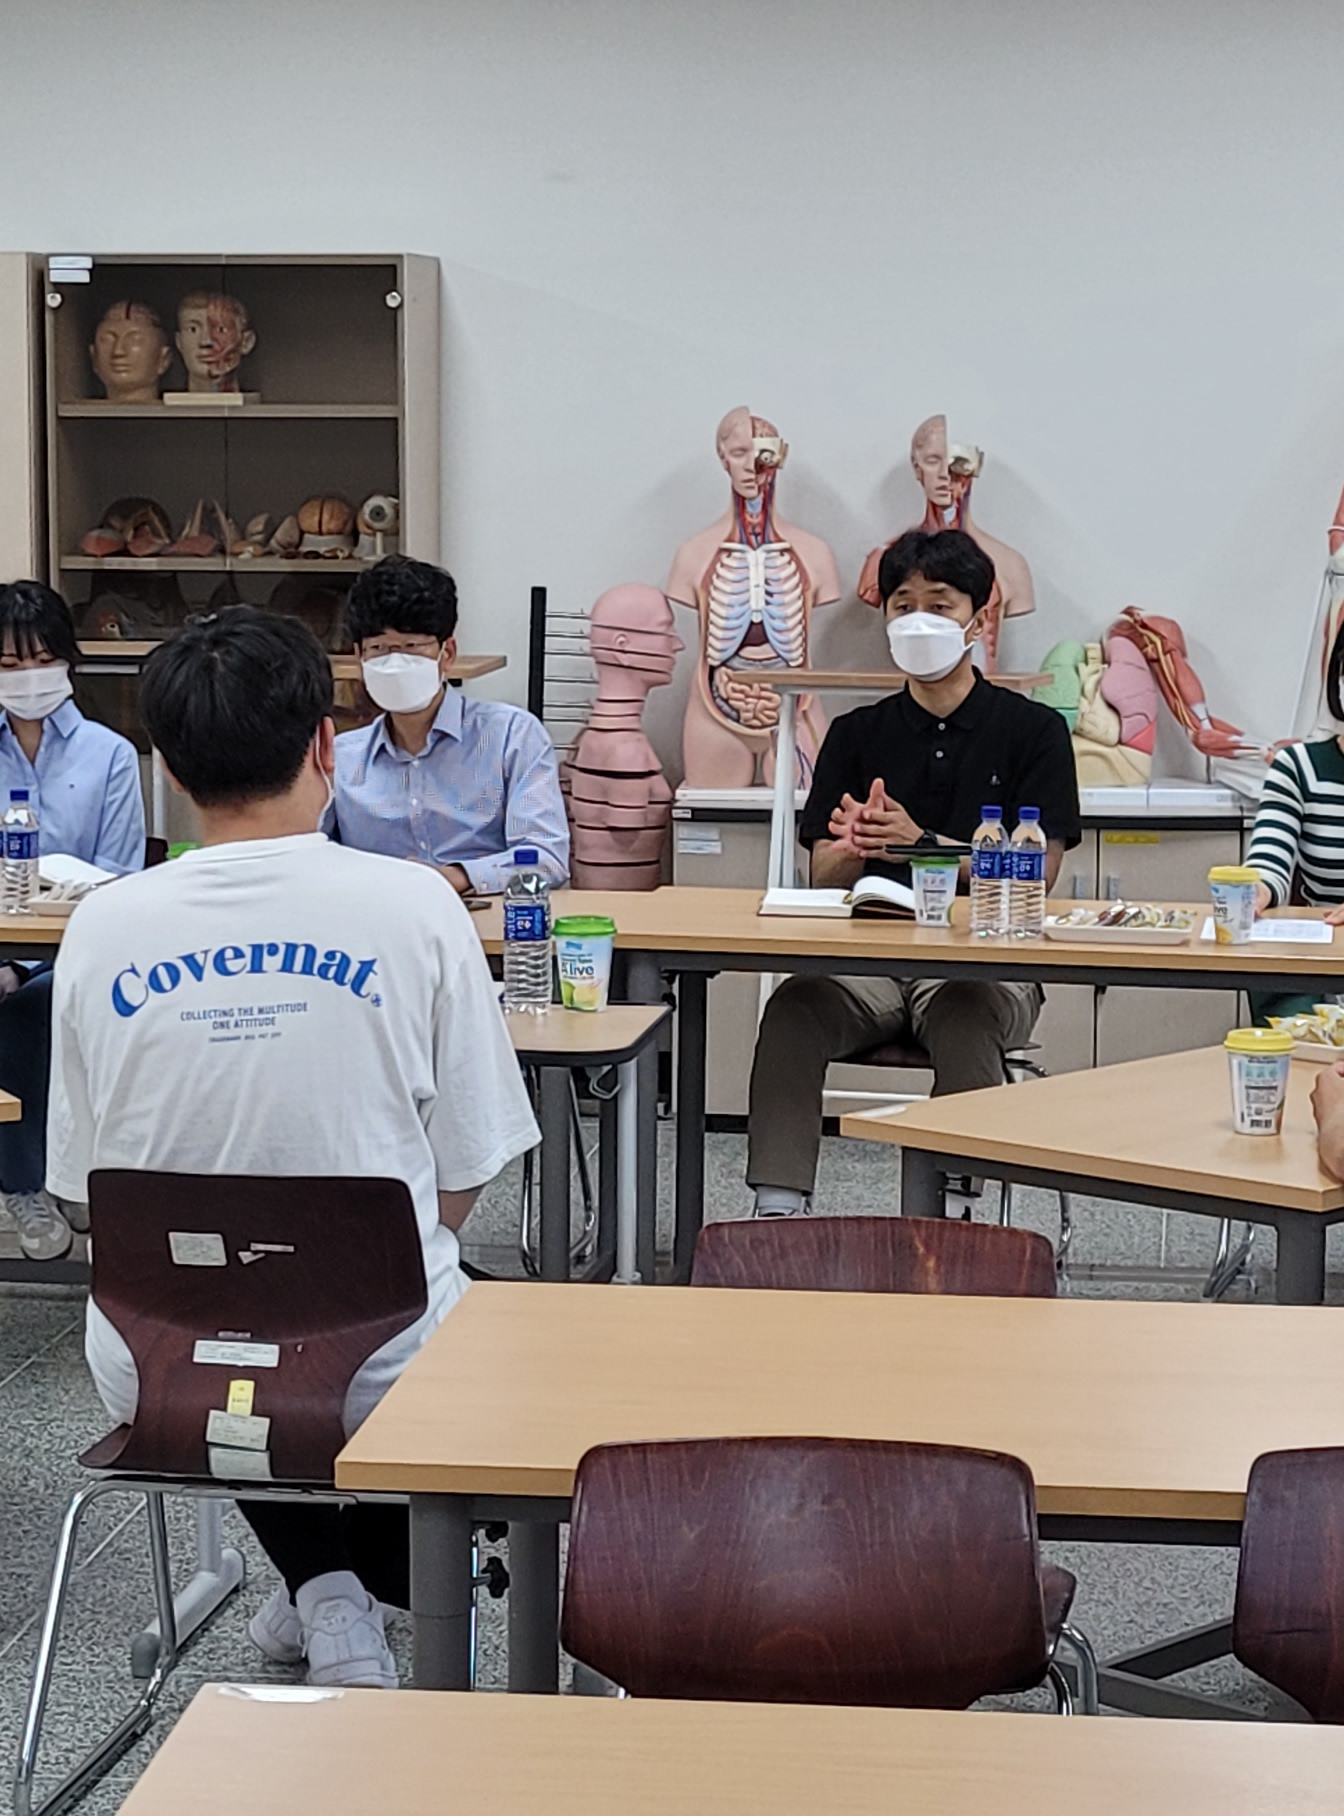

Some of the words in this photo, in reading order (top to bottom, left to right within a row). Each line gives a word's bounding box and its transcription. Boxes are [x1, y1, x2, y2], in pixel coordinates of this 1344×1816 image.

[111, 941, 379, 1019] Covernat
[180, 1007, 235, 1022] COLLECTING
[237, 1006, 255, 1017] THE
[257, 1002, 309, 1015] MULTITUDE
[212, 1020, 231, 1031] ONE
[233, 1016, 277, 1029] ATTITUDE
